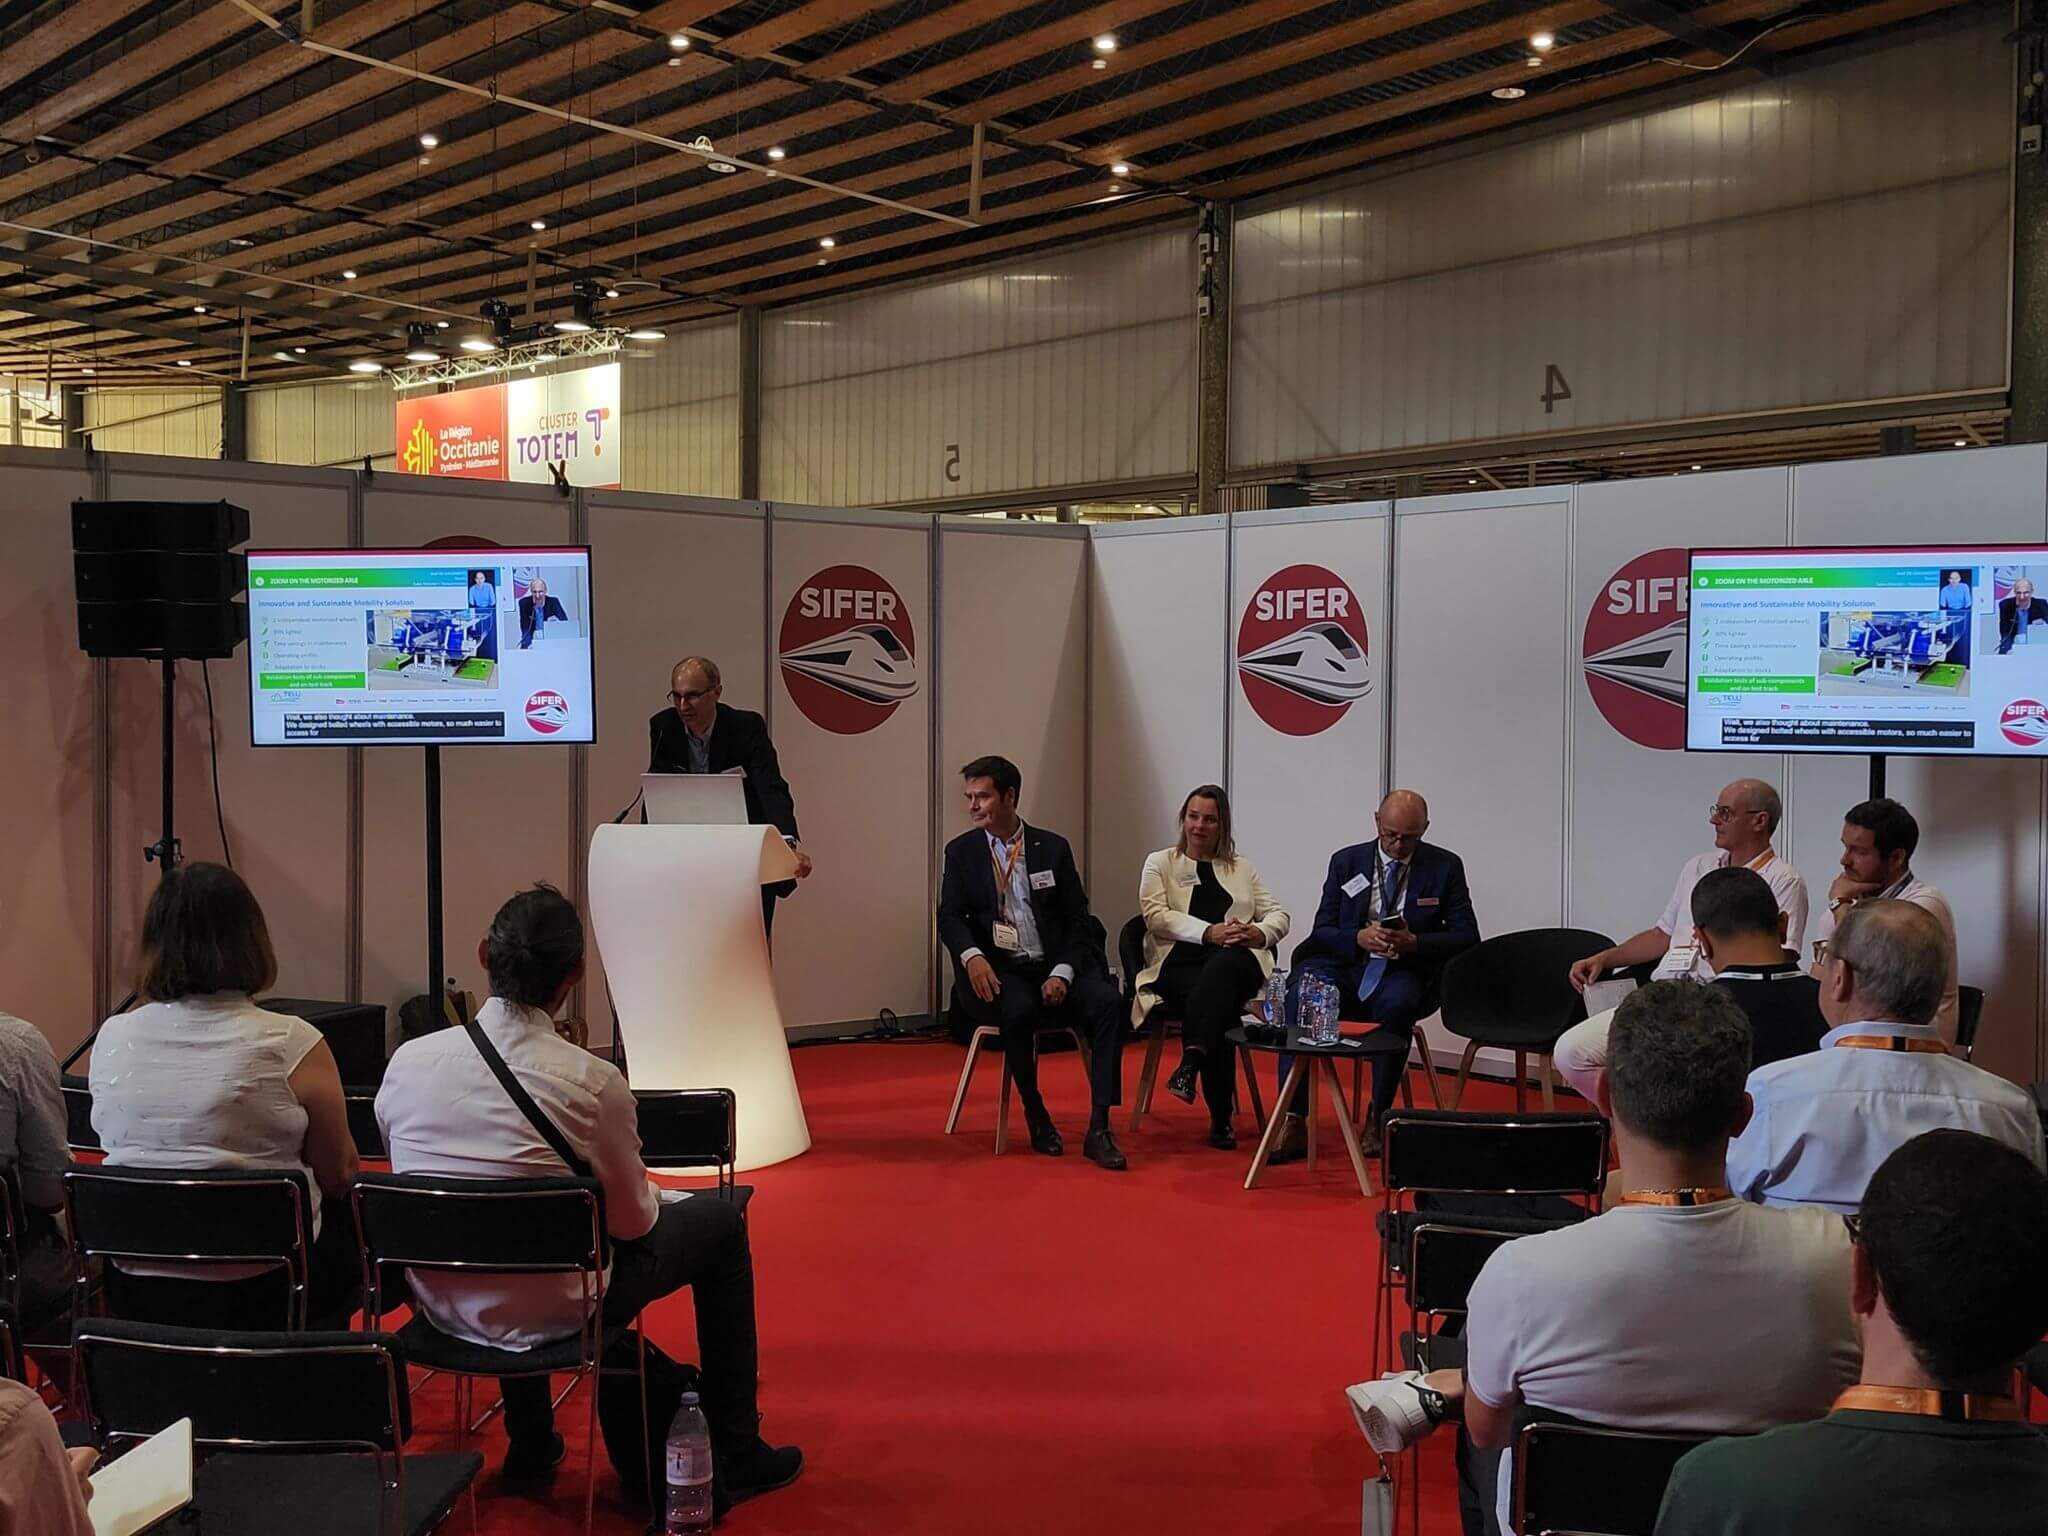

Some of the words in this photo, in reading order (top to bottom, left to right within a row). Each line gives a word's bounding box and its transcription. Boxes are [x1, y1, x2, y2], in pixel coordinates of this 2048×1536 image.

[539, 412, 578, 431] CLUSTER
[440, 428, 449, 440] La
[449, 425, 472, 440] Région
[440, 434, 500, 461] Occitanie
[517, 430, 578, 464] TOTEM
[270, 577, 289, 585] ZOOM
[1714, 577, 1735, 585] ZOOM
[1735, 577, 1746, 585] ON
[1747, 577, 1759, 585] THE
[1607, 577, 1688, 615] SIFE
[258, 600, 296, 608] Innovative
[312, 600, 353, 608] Sustainable
[354, 600, 383, 609] Mobility
[800, 587, 897, 620] SIFER
[1255, 587, 1349, 621] SIFER
[1700, 600, 1741, 609] Innovative
[1742, 600, 1758, 608] and
[1759, 600, 1805, 608] Sustainable
[1807, 600, 1841, 609] Mobility
[1842, 600, 1876, 608] Solution
[530, 695, 562, 705] SIFER
[2006, 705, 2046, 715] SIFER
[298, 721, 328, 730] designed
[1771, 720, 1799, 728] thought
[1821, 720, 1870, 728] maintenance.
[1737, 727, 1770, 736] designed
[1837, 728, 1876, 736] accessible
[1876, 729, 1905, 737] motors,
[1916, 729, 1938, 737] much
